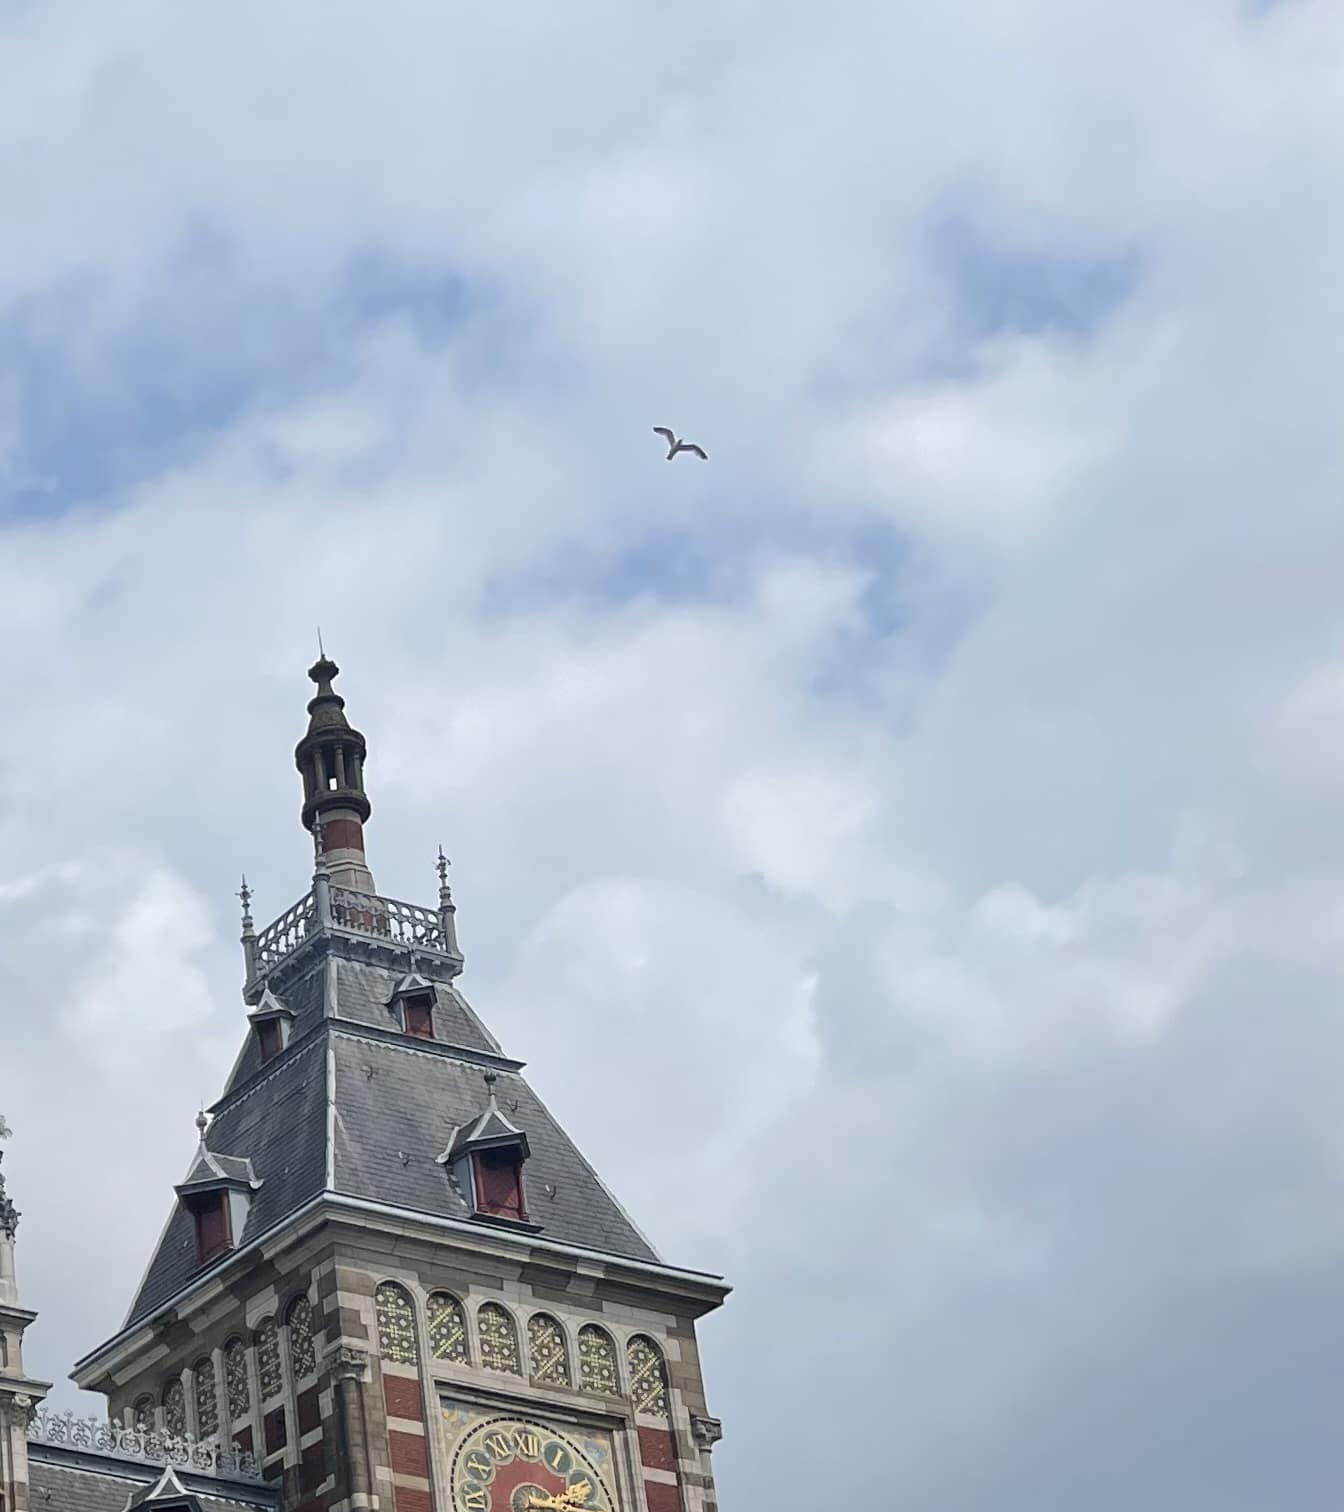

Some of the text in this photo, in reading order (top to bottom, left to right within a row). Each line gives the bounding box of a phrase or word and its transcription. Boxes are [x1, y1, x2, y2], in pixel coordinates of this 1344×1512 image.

[485, 1436, 511, 1459] XI
[514, 1432, 540, 1457] XII
[467, 1451, 493, 1477] X
[551, 1450, 565, 1468] I
[464, 1488, 486, 1510] IX
